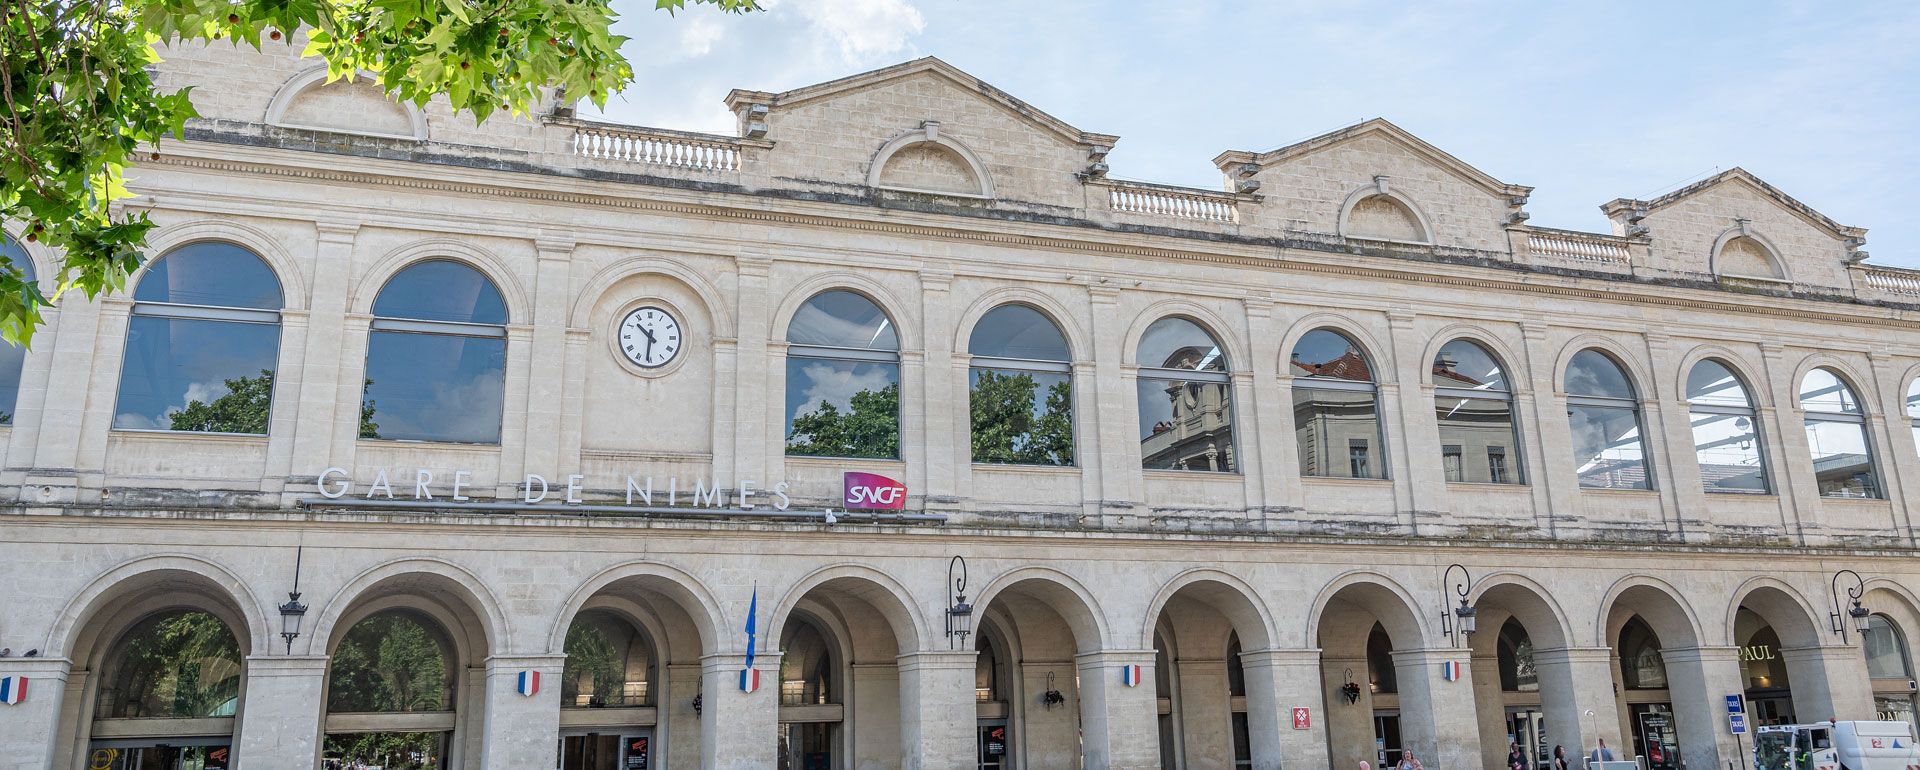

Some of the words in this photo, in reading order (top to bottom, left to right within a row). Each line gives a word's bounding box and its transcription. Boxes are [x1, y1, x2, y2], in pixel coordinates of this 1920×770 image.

[318, 467, 472, 500] GARE
[525, 473, 584, 503] DE
[626, 475, 790, 511] NIMES
[847, 486, 905, 504] SNCF
